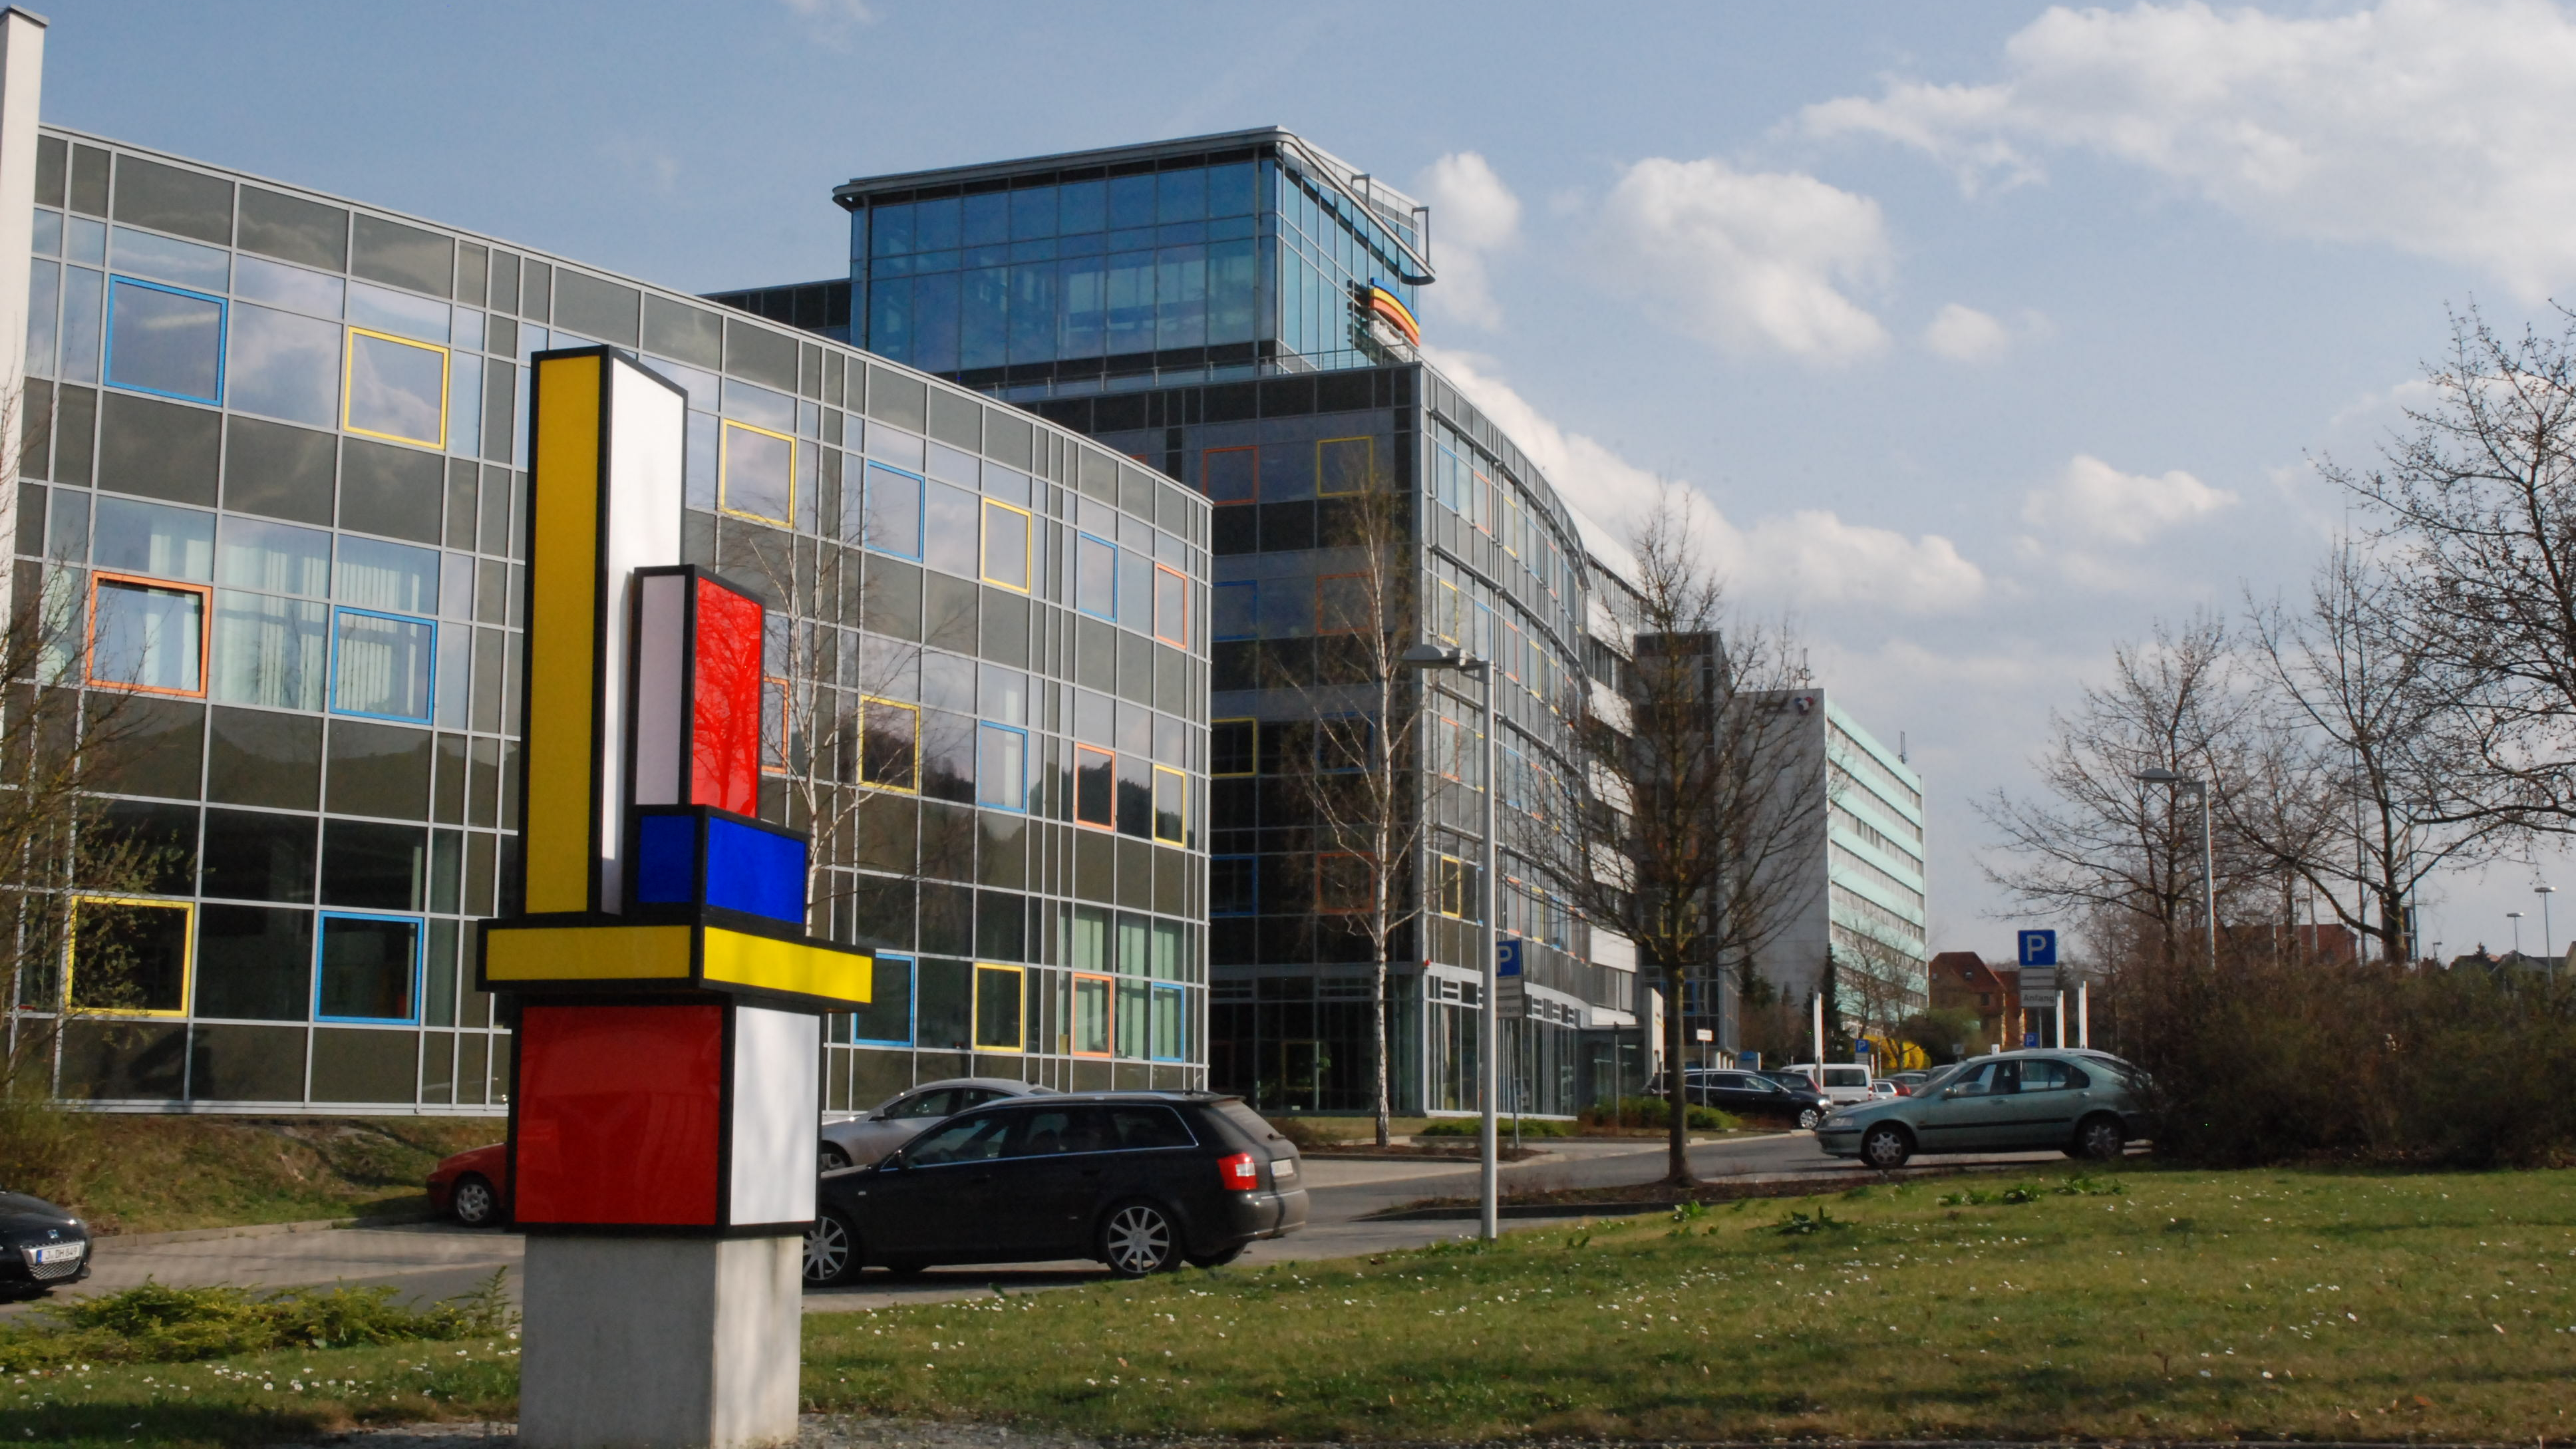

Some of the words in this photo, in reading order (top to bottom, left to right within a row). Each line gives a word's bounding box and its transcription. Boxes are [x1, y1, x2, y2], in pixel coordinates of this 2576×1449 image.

[2027, 934, 2046, 961] P
[1496, 945, 1512, 973] P
[2023, 993, 2054, 1004] Anfang
[2026, 1035, 2034, 1045] P
[1858, 1041, 1865, 1051] P
